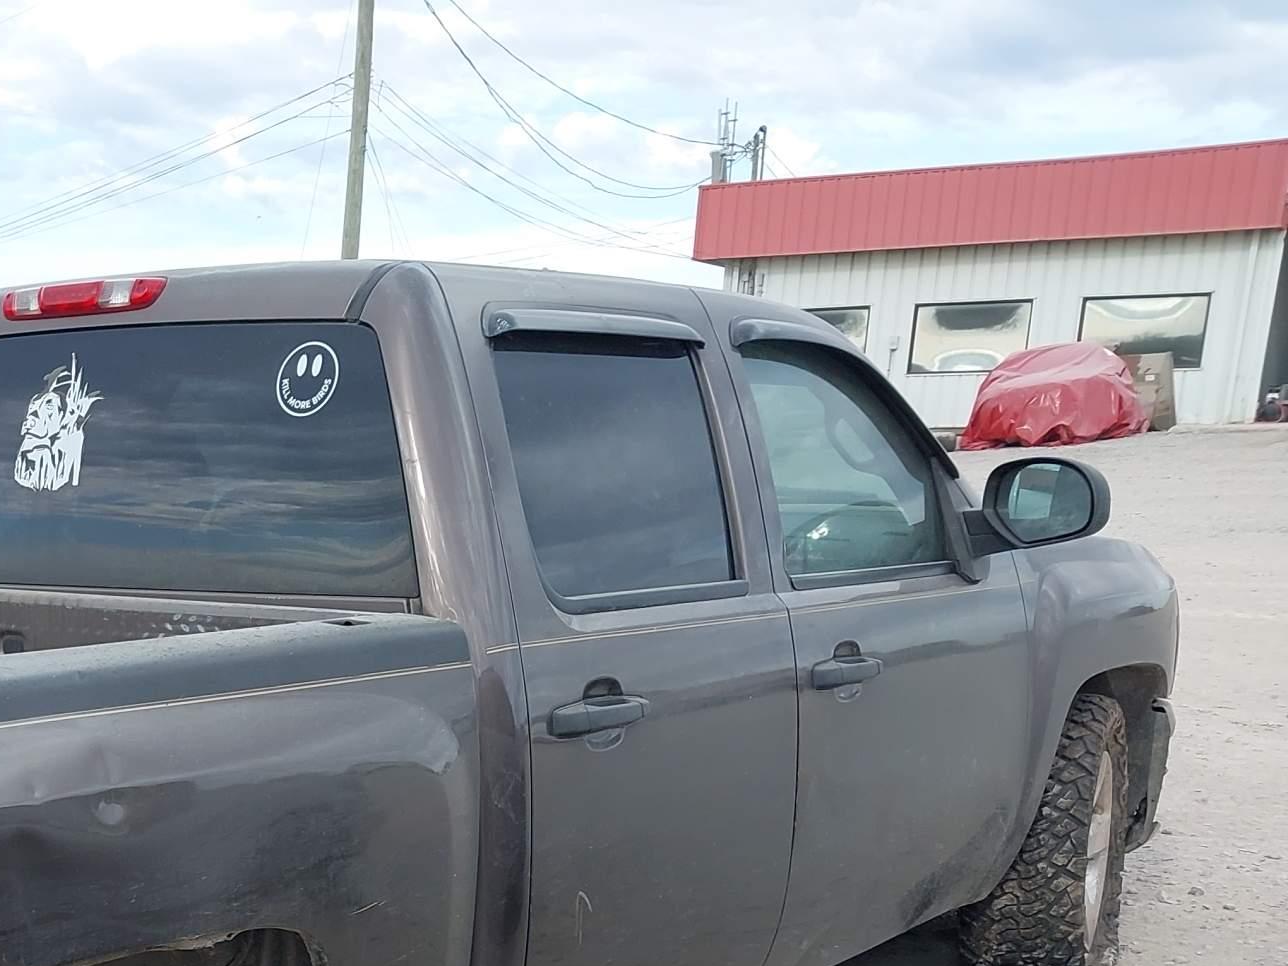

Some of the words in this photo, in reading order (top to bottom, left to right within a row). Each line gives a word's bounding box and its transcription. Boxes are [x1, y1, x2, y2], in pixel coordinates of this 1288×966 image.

[281, 377, 291, 400] KILL
[287, 396, 312, 410] MORE
[312, 377, 332, 406] BIRDS
